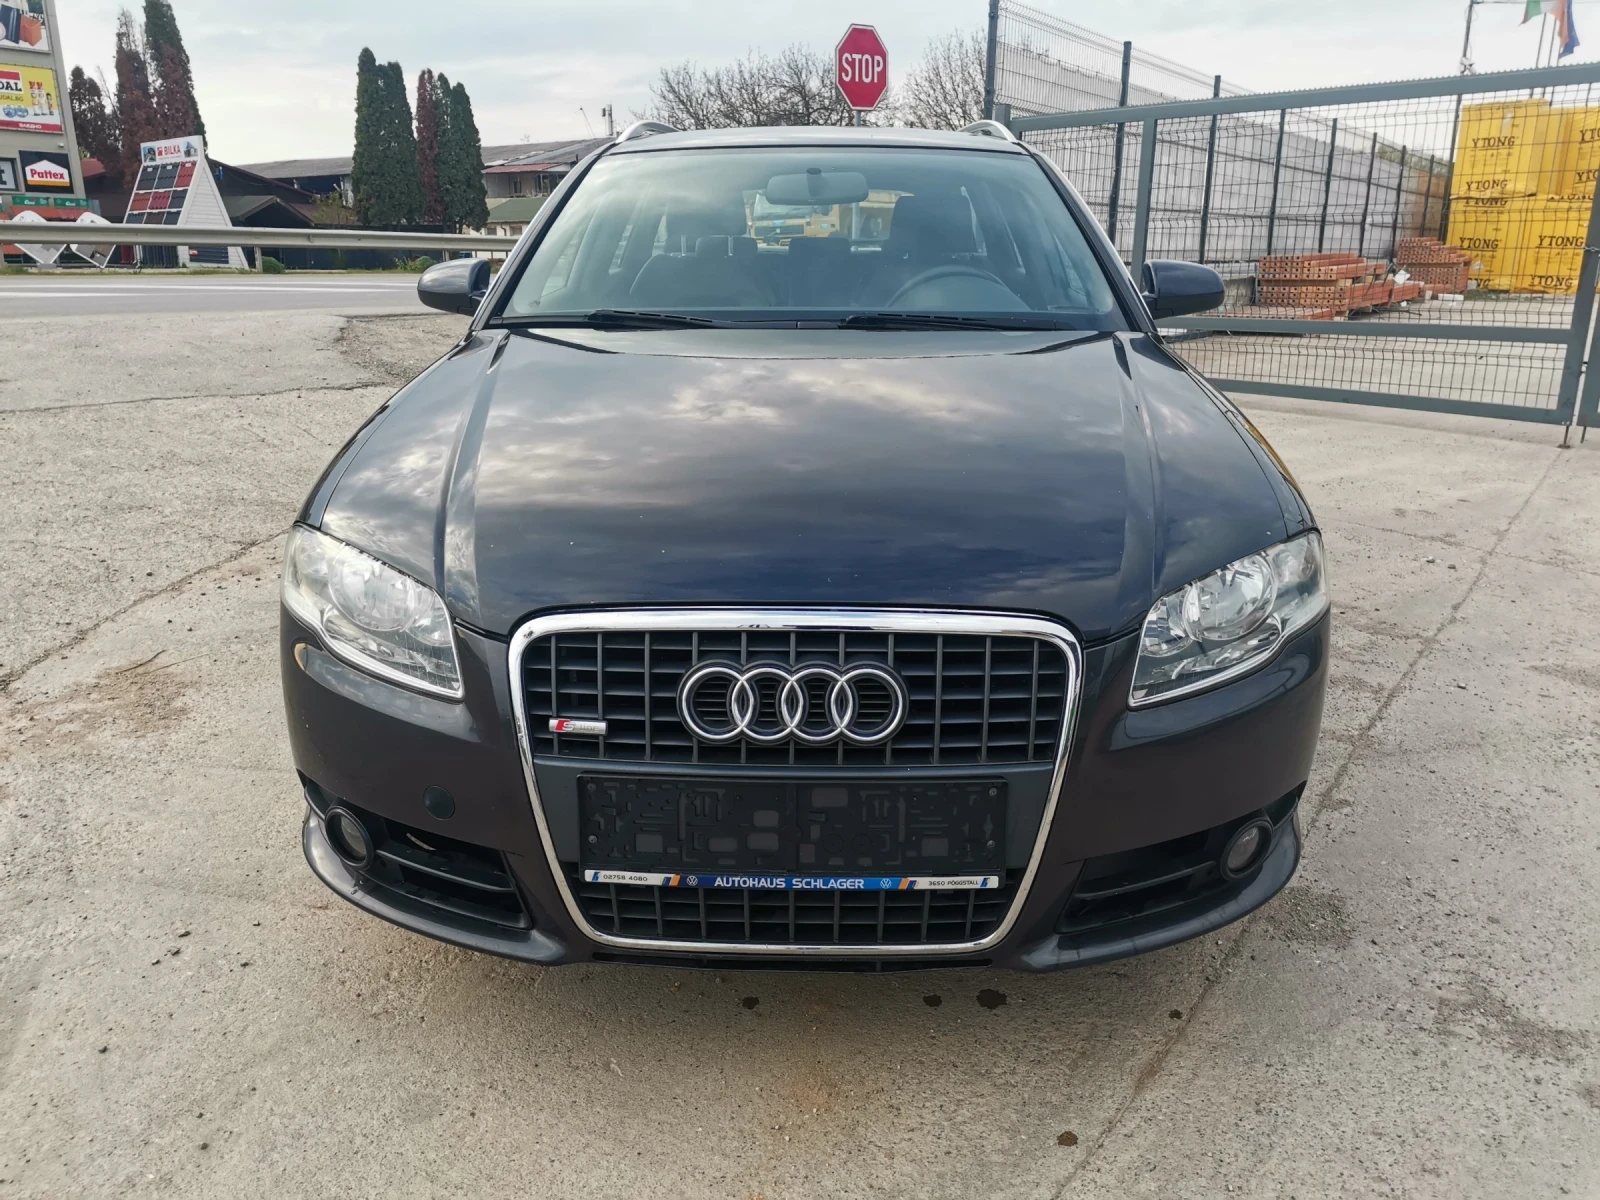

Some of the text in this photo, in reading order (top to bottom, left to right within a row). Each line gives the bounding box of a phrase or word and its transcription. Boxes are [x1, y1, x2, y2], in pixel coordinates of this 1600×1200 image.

[841, 52, 884, 83] STOP
[1472, 136, 1515, 148] YTONG
[164, 144, 181, 155] BILKA
[30, 168, 65, 180] Pattex
[1466, 179, 1508, 191] YTONG
[1459, 237, 1499, 250] YTONG
[1538, 235, 1584, 247] YTONG
[1530, 274, 1573, 288] YTONG
[580, 723, 600, 732] line
[714, 876, 864, 889] AUTOHAUS SCHLAGER
